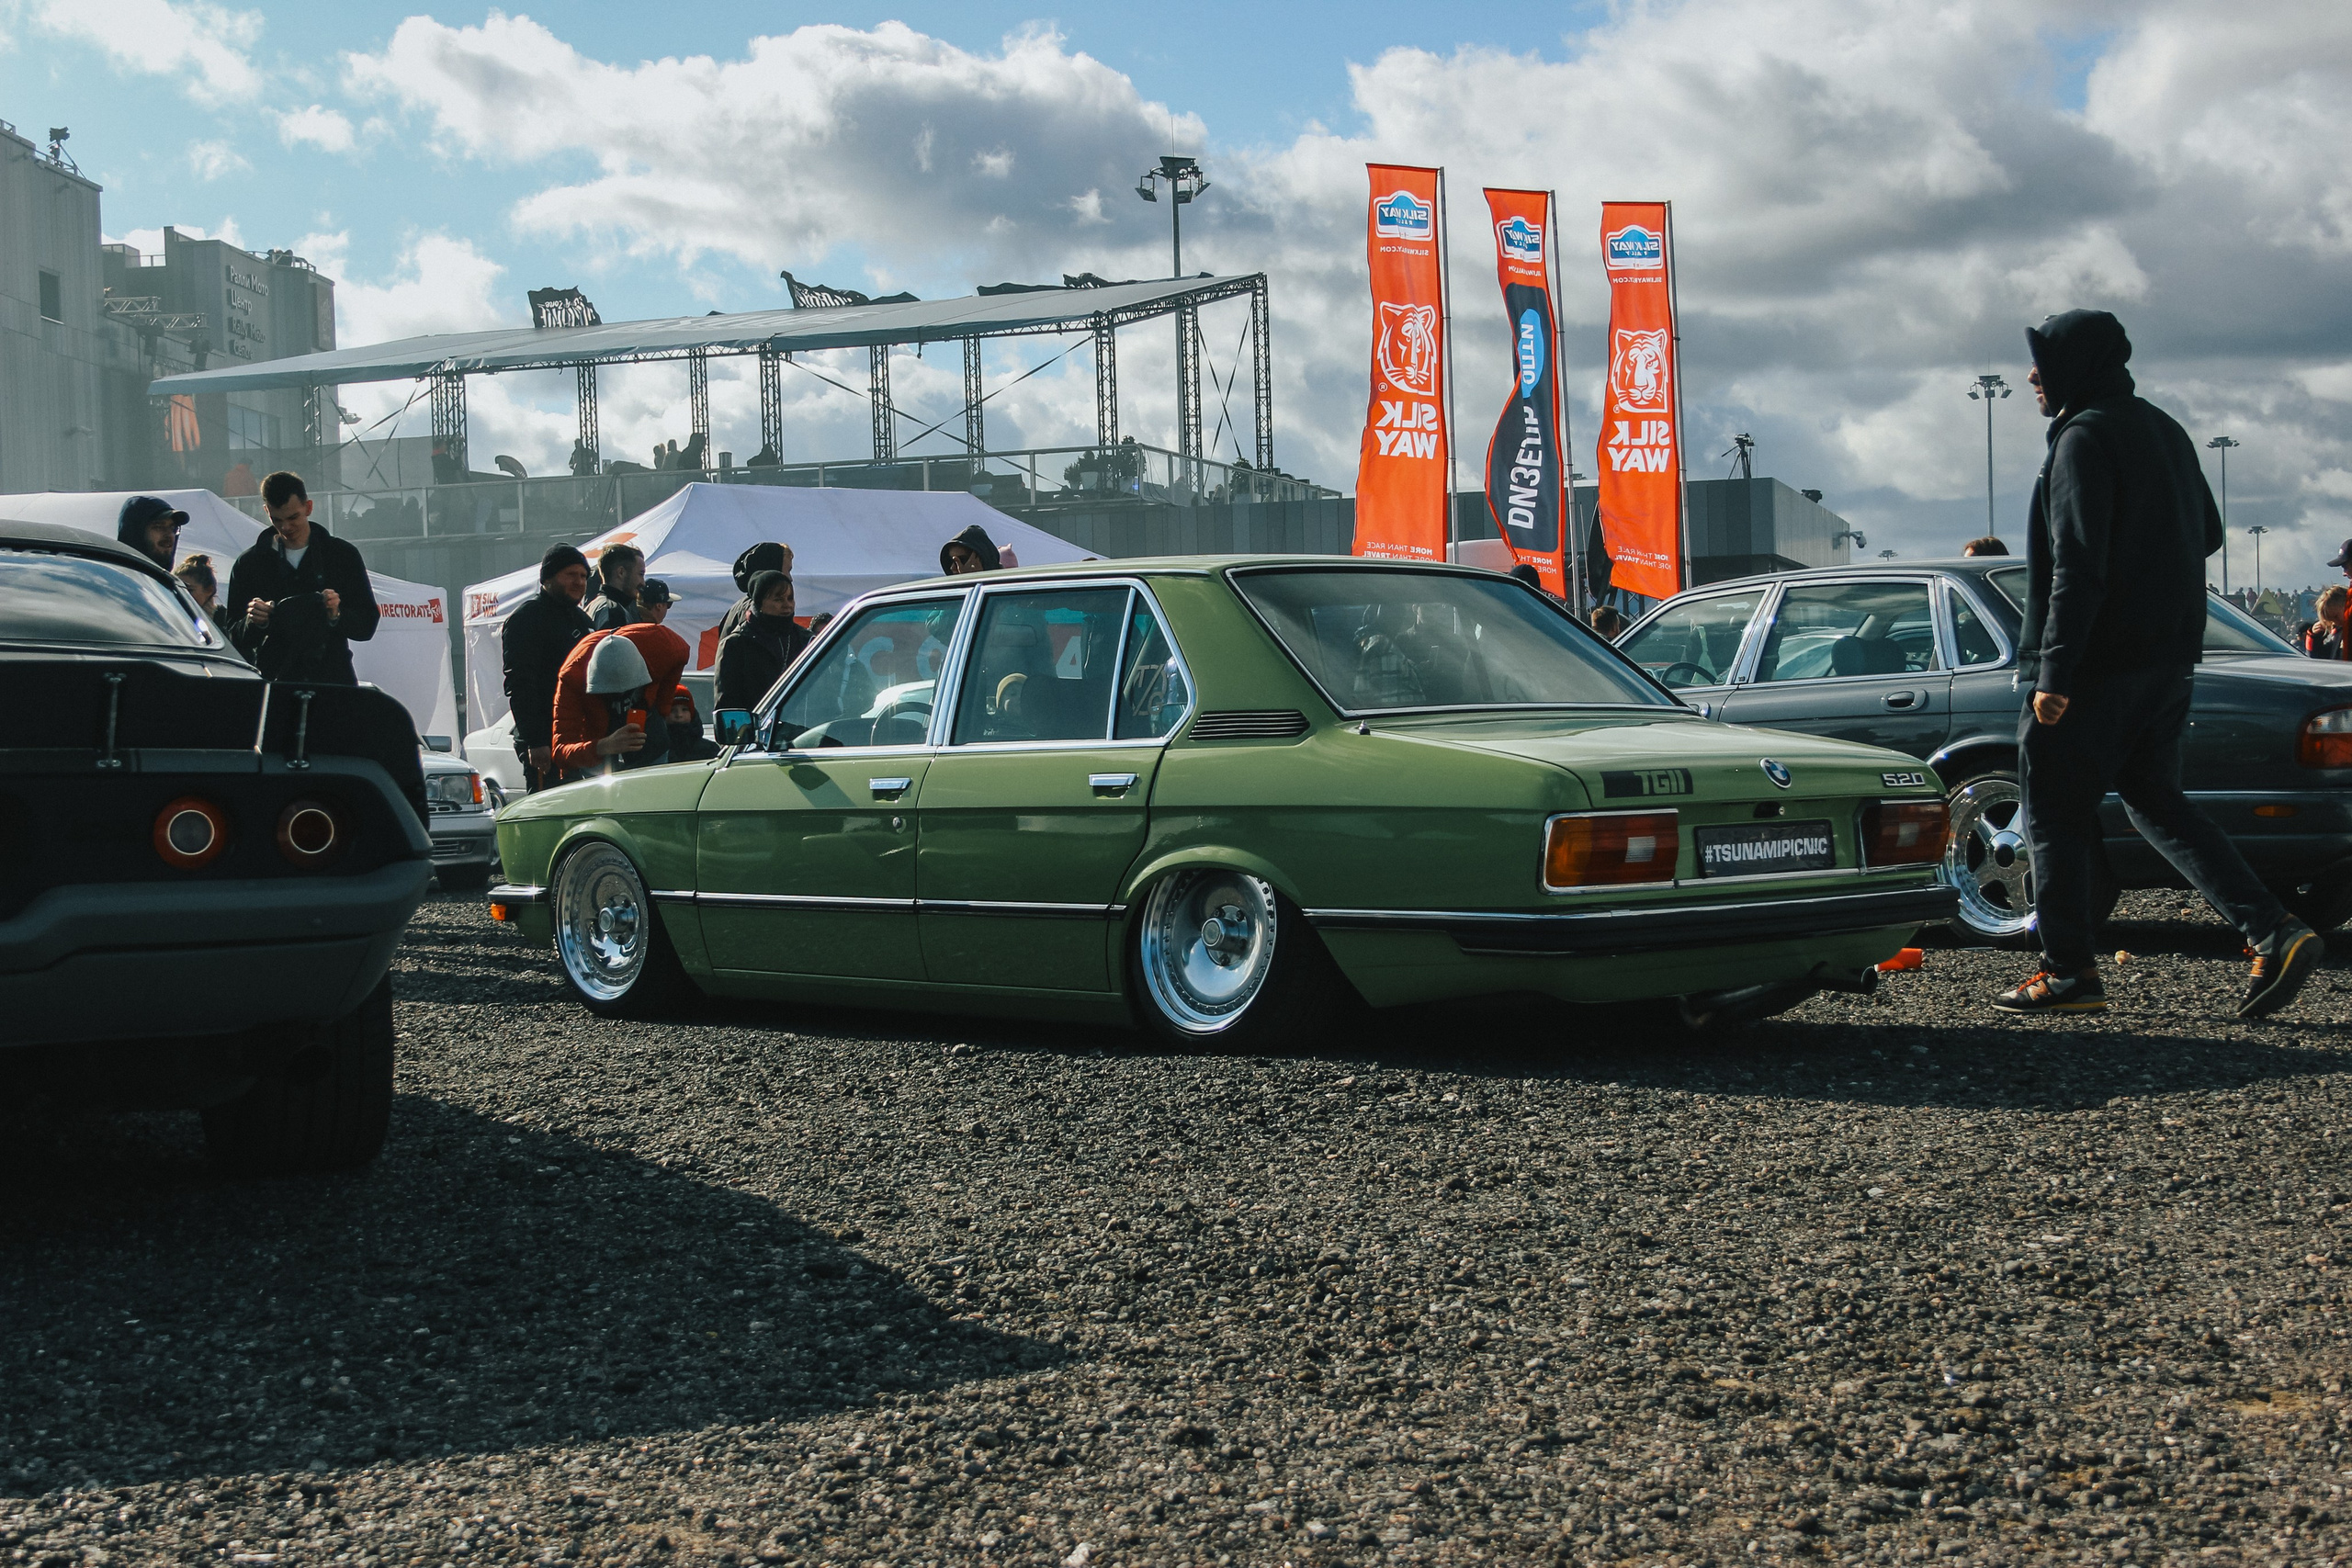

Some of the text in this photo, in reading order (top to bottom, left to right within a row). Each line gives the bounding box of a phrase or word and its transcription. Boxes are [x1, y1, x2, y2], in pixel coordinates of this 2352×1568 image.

[230, 265, 269, 296] Ралли Мото
[232, 288, 253, 315] Центр
[482, 592, 499, 605] SILK
[1882, 773, 1927, 786] 520
[1704, 837, 1828, 863] #TSUNAMIPICNIC
